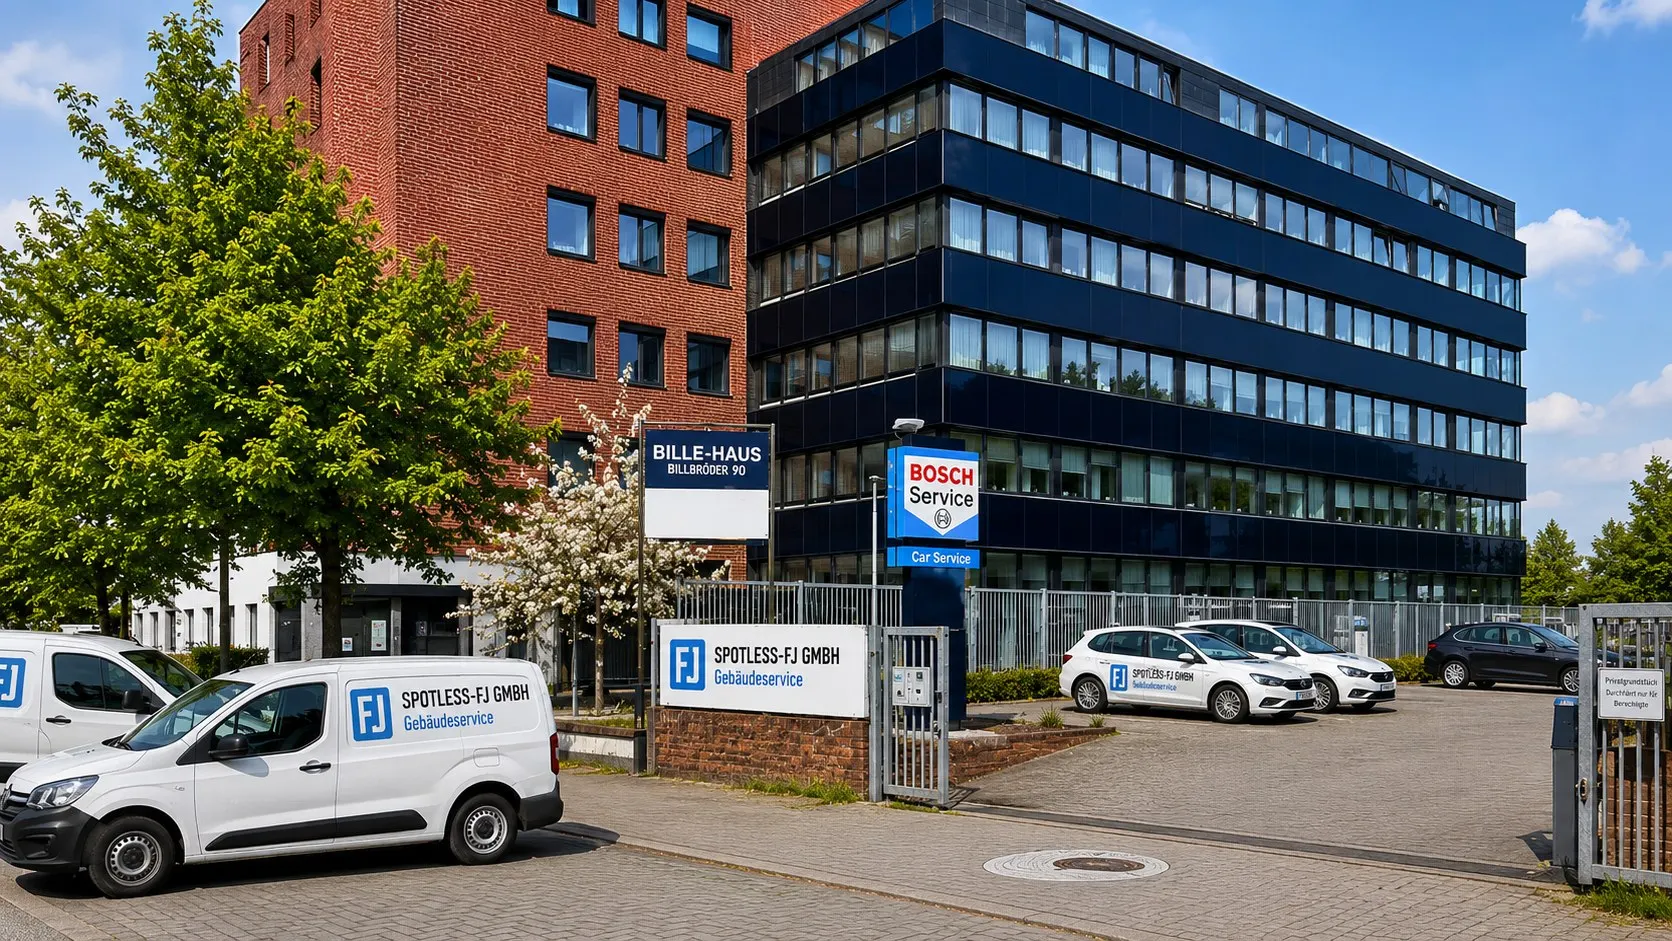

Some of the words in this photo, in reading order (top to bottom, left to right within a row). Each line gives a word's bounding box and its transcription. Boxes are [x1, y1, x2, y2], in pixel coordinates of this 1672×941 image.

[653, 444, 762, 462] BILLE-HAUS
[667, 462, 728, 476] BILLBRÖDER
[732, 465, 746, 476] 90
[910, 463, 973, 486] BOSCH
[910, 486, 973, 508] Service
[911, 550, 929, 563] Car
[933, 551, 971, 565] Service
[675, 646, 700, 685] FJ
[714, 646, 798, 665] SPOTLESS-FJ
[801, 646, 840, 665] GMBH
[714, 669, 803, 687] Gebäudeservice
[1112, 668, 1126, 688] FJ
[402, 686, 490, 709] SPOTLESS-FJ
[494, 683, 530, 703] GMBH
[357, 694, 388, 735] FJ
[404, 711, 494, 732] Gebäudeservice
